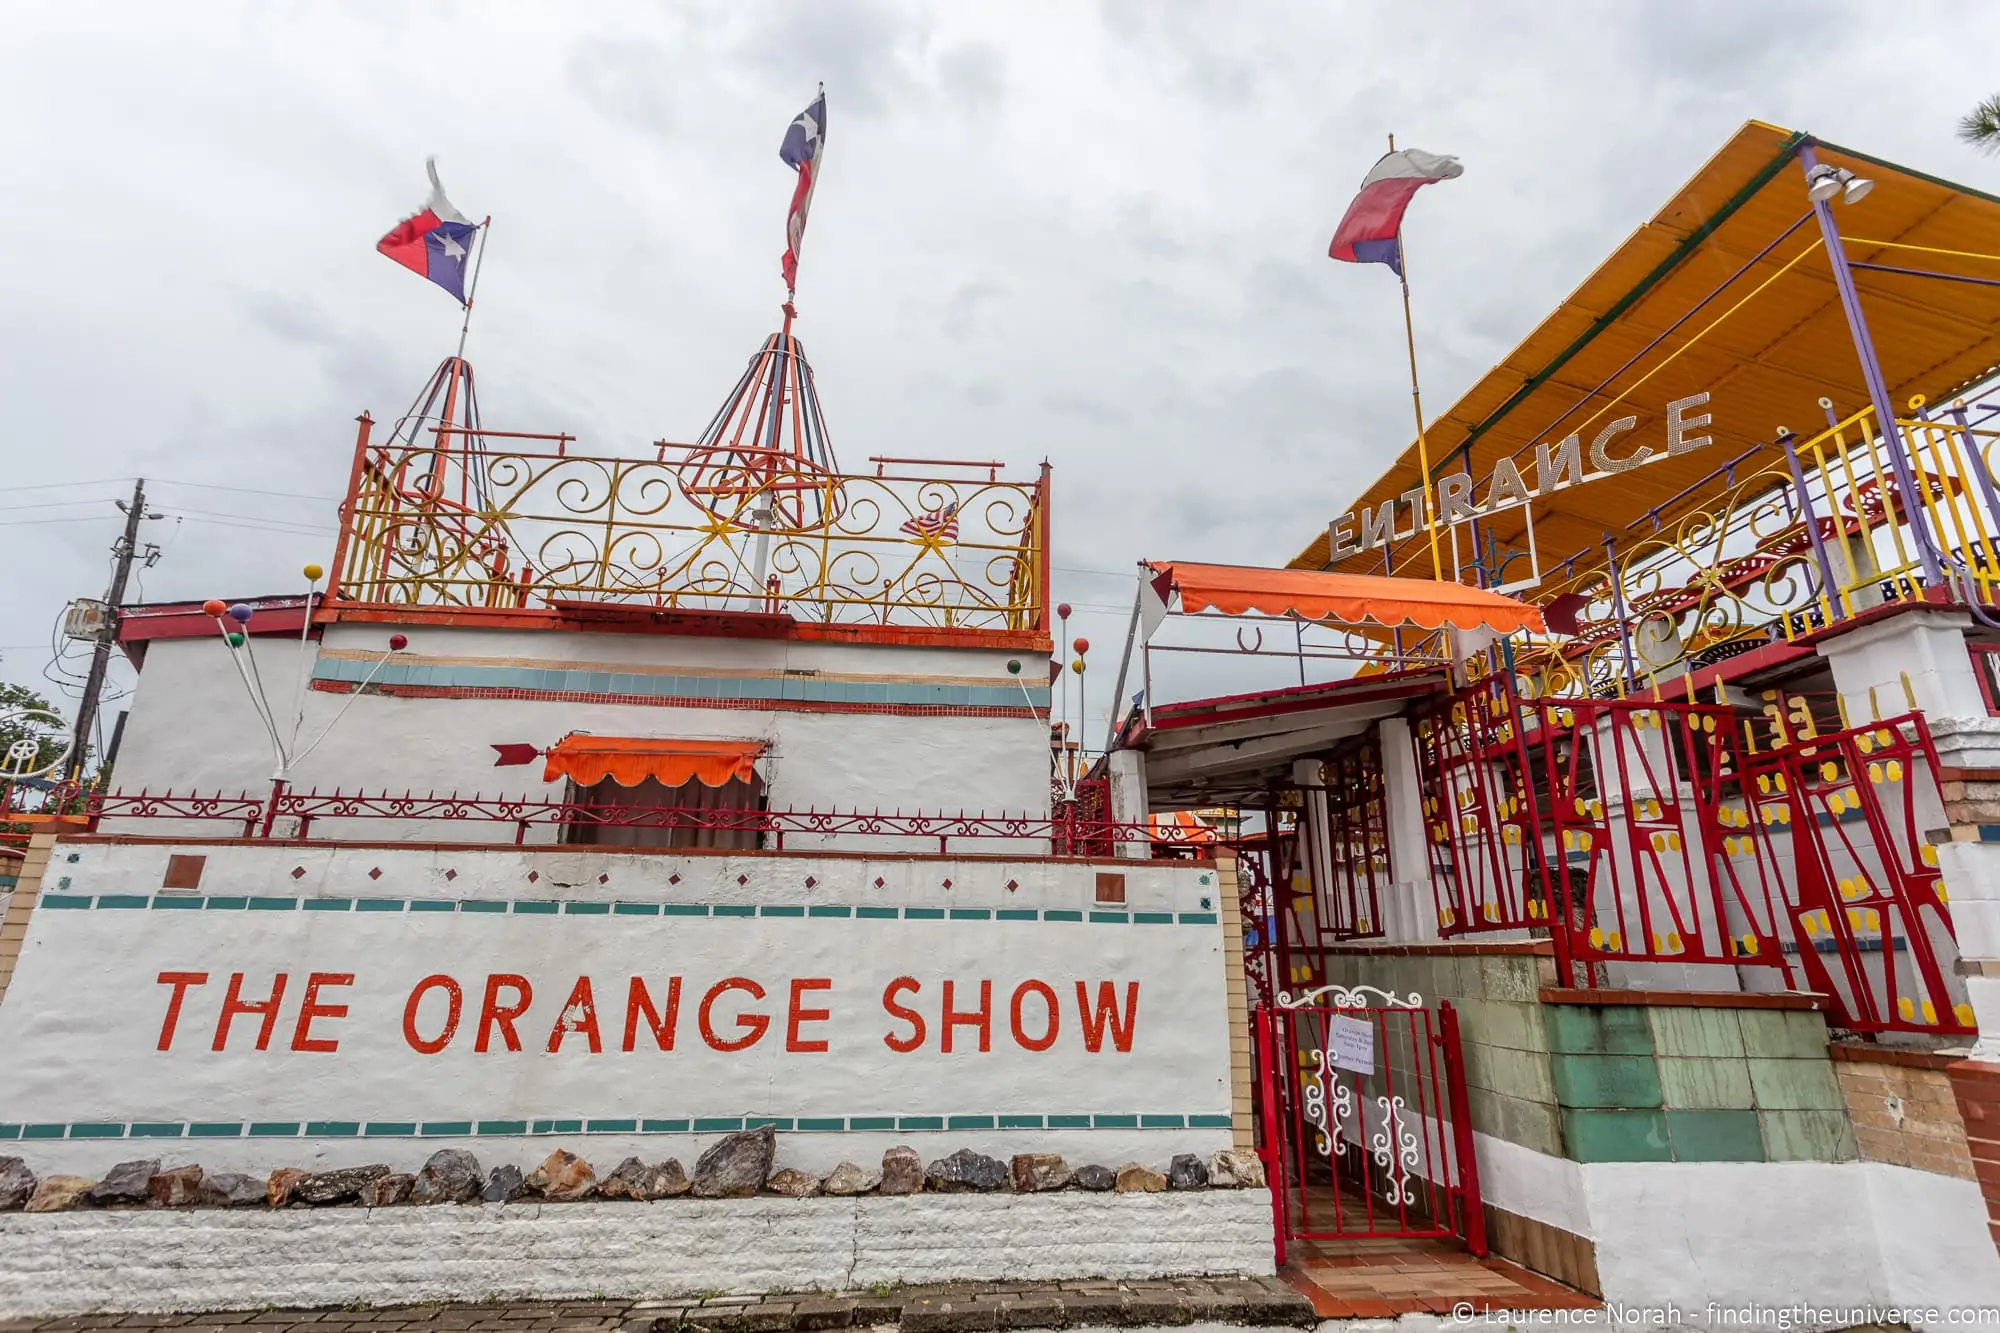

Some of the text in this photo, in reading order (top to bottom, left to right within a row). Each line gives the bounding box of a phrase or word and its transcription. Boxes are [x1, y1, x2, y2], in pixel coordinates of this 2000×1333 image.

[156, 971, 1140, 1055] THE ORANGE SHOW
